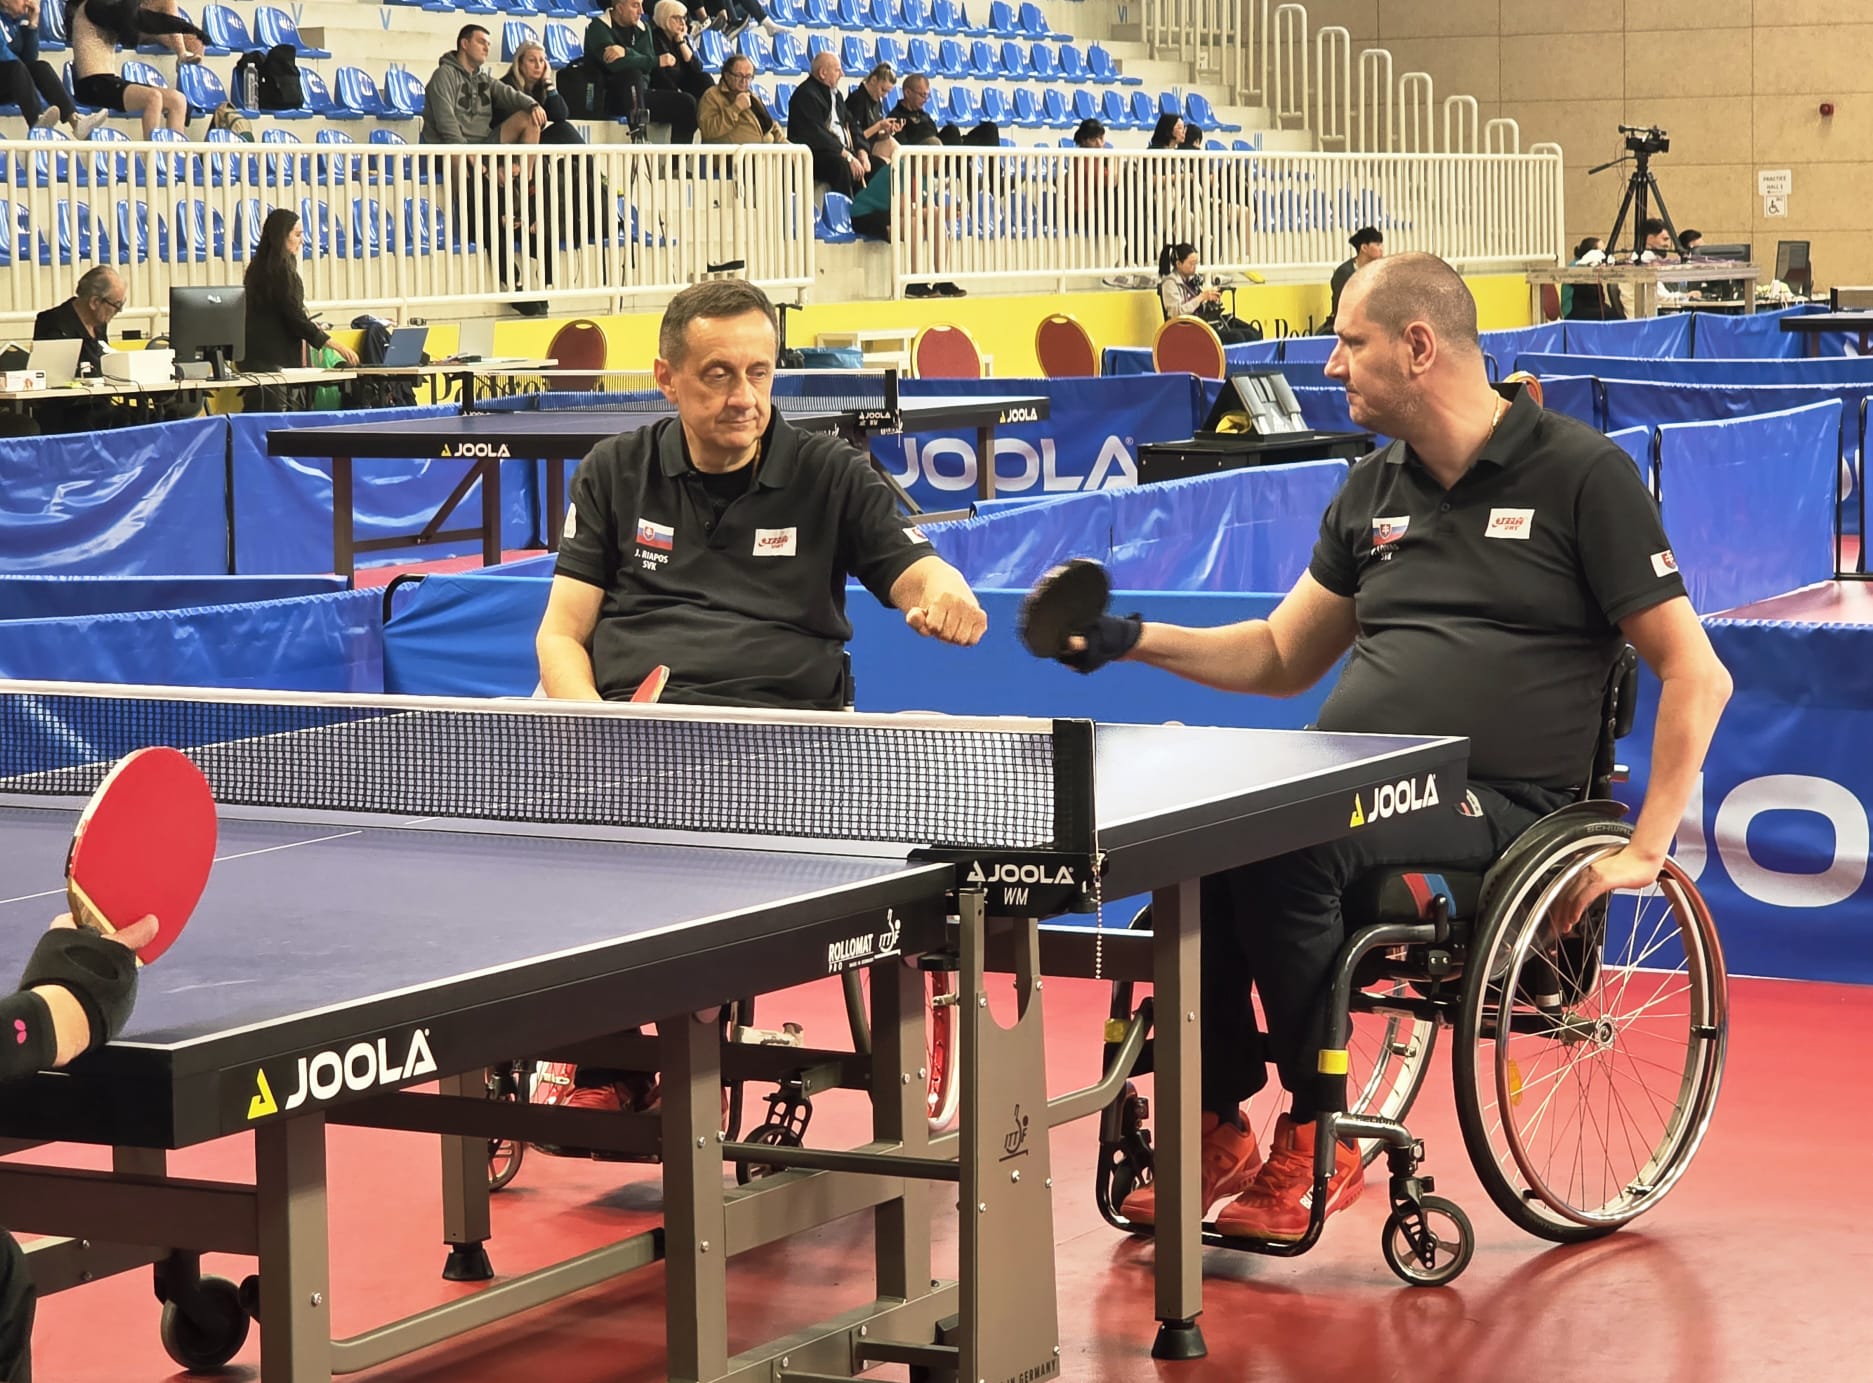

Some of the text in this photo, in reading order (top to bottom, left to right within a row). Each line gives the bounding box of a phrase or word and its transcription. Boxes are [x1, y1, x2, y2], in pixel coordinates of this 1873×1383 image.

[1007, 407, 1038, 422] JOOLA
[454, 442, 511, 457] JOOLA
[642, 560, 657, 571] SVK
[1367, 774, 1440, 823] JOOLA
[987, 863, 1075, 884] JOOLA
[1004, 887, 1029, 905] WM
[828, 933, 874, 962] ROLLOMAT
[285, 1028, 438, 1110] JOOLA
